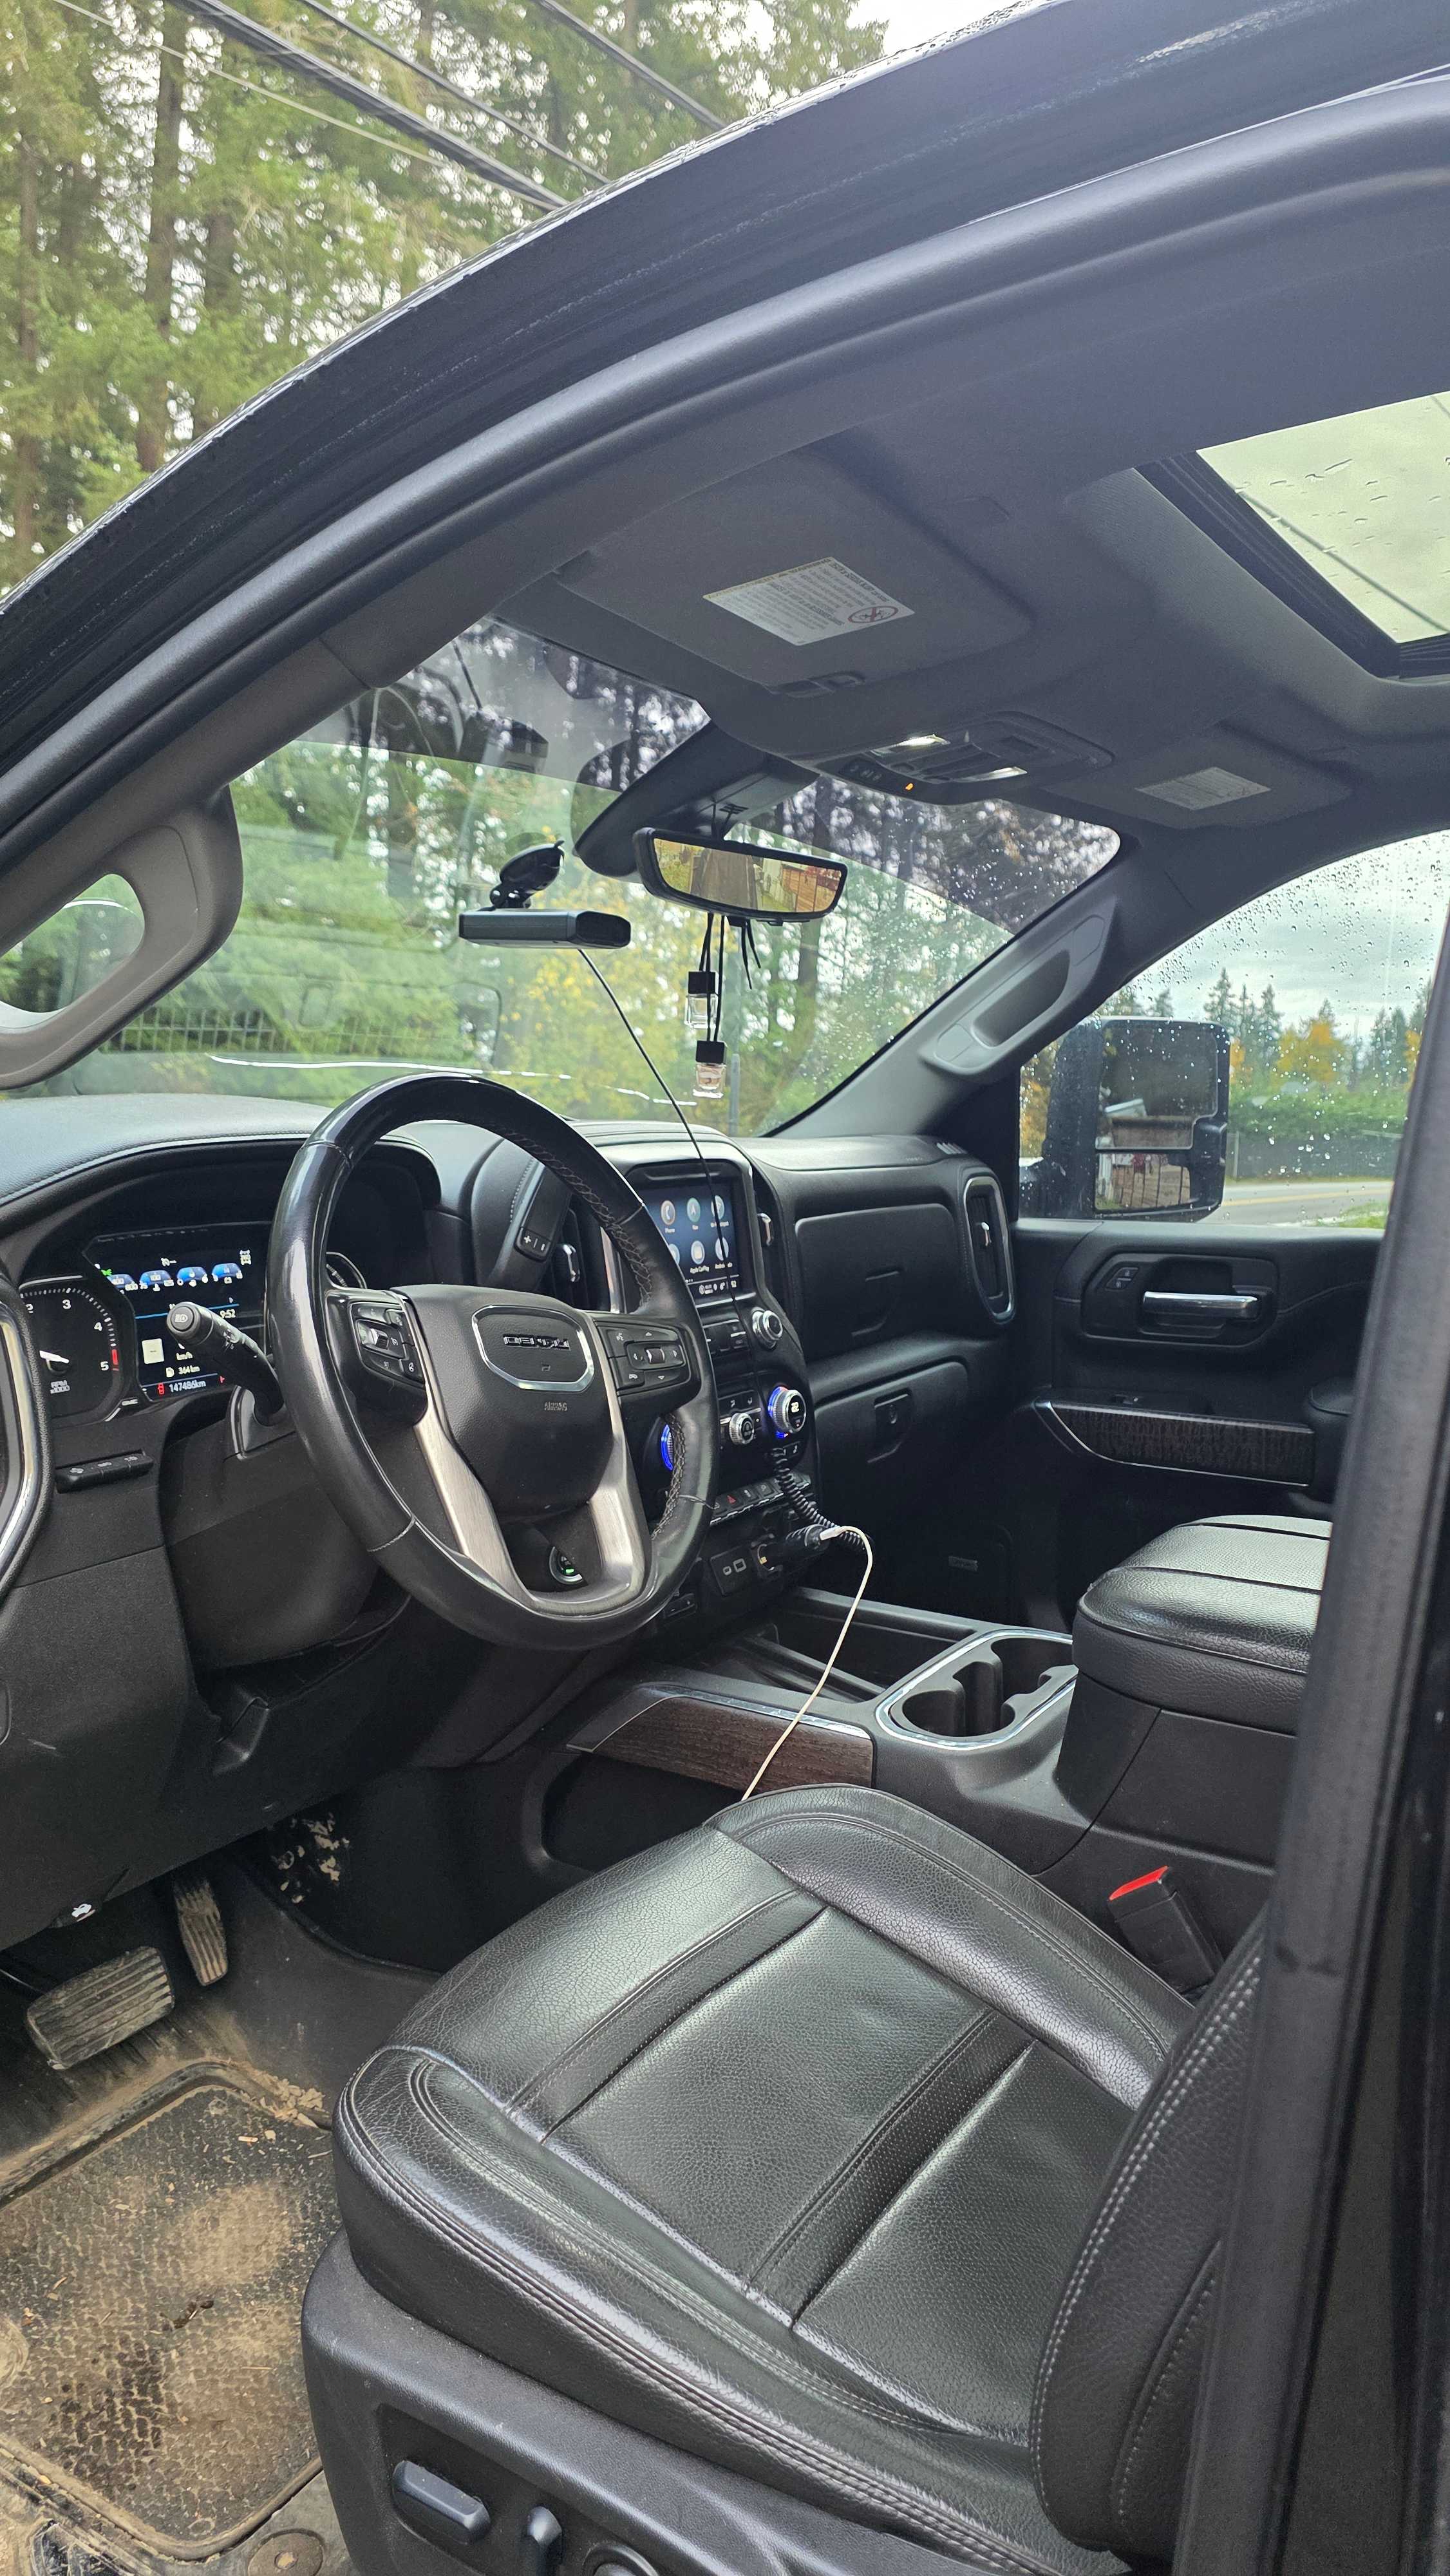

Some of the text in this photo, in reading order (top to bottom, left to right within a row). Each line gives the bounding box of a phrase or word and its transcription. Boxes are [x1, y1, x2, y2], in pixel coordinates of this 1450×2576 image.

[62, 1299, 71, 1309] 3
[93, 1321, 102, 1331] 4
[100, 1361, 109, 1371] 5
